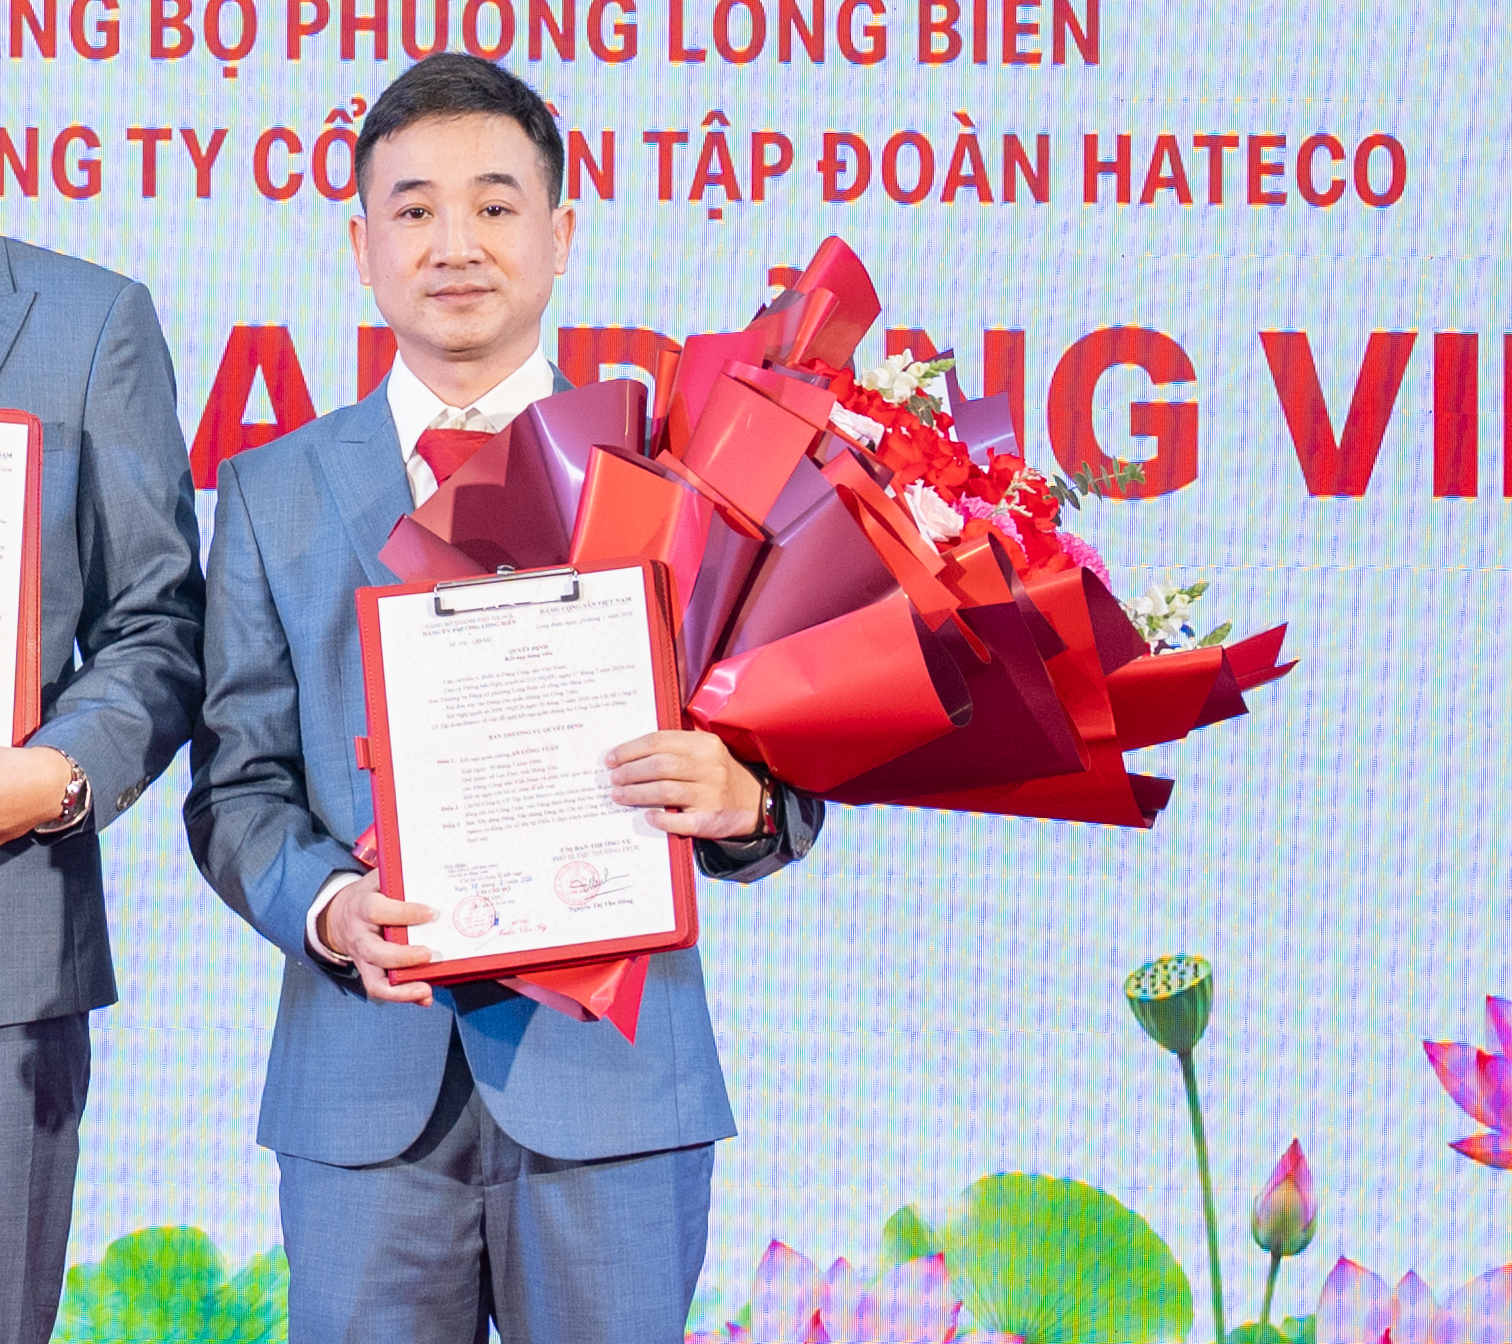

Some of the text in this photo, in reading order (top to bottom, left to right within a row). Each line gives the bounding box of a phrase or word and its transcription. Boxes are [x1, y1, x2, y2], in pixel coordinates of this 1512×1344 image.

[126, 127, 227, 197] TY
[253, 95, 367, 201] CỔ
[642, 111, 793, 220] TẬP
[816, 113, 1050, 205] ĐOÀN
[1083, 133, 1407, 208] HATECO
